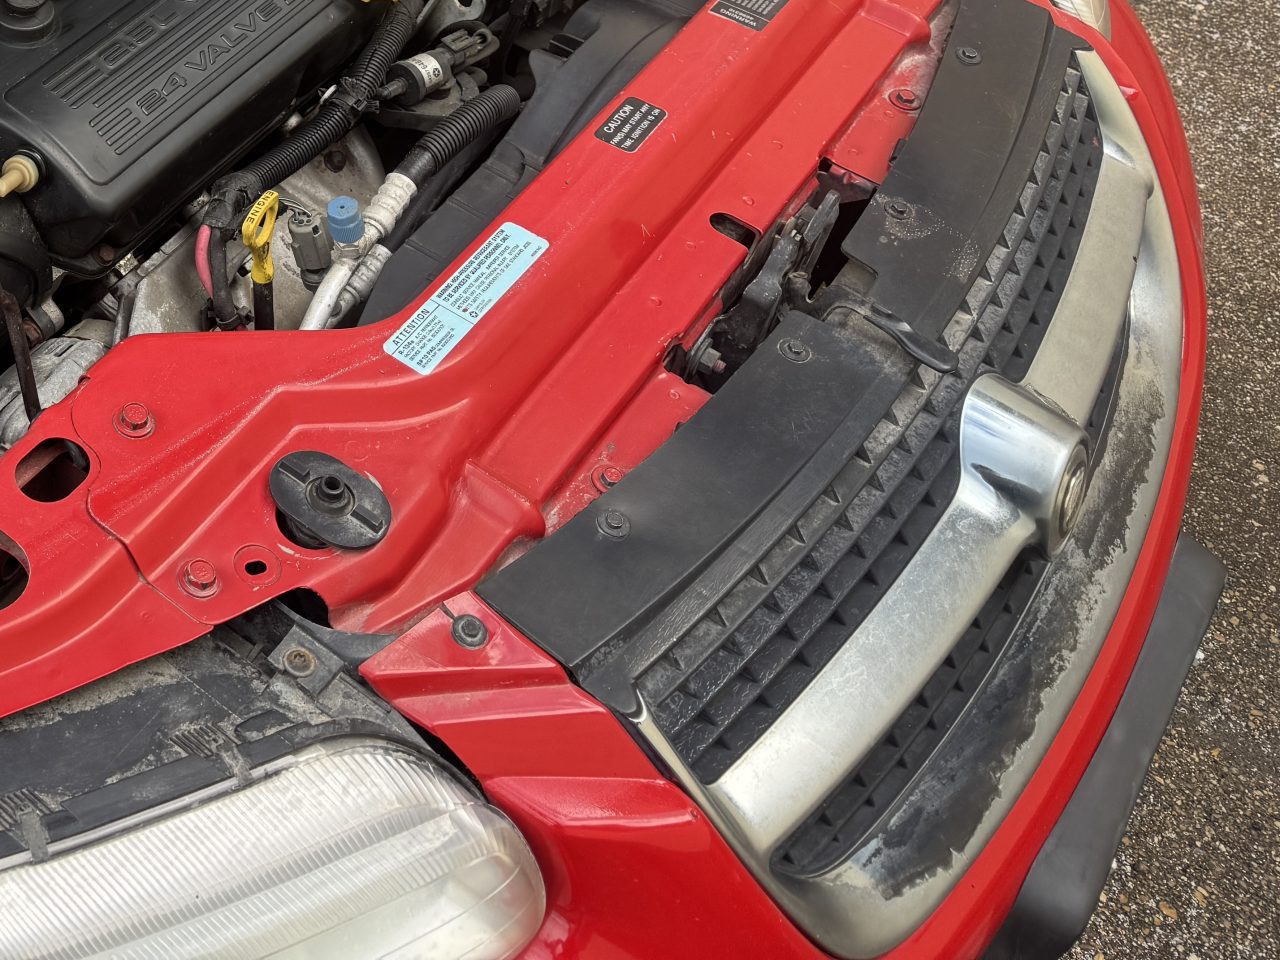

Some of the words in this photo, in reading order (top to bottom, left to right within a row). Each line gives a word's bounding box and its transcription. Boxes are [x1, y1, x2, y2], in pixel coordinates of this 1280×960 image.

[720, 8, 757, 27] WARNING
[136, 71, 188, 117] 24
[603, 104, 634, 133] CAUTION
[621, 122, 633, 134] MAY
[628, 111, 643, 125] START
[640, 103, 651, 114] ANY
[621, 138, 635, 149] TIME
[630, 119, 651, 140] IGNITION
[651, 108, 661, 116] ON
[247, 191, 275, 224] ENGINE
[391, 307, 430, 346] ATTENTION
